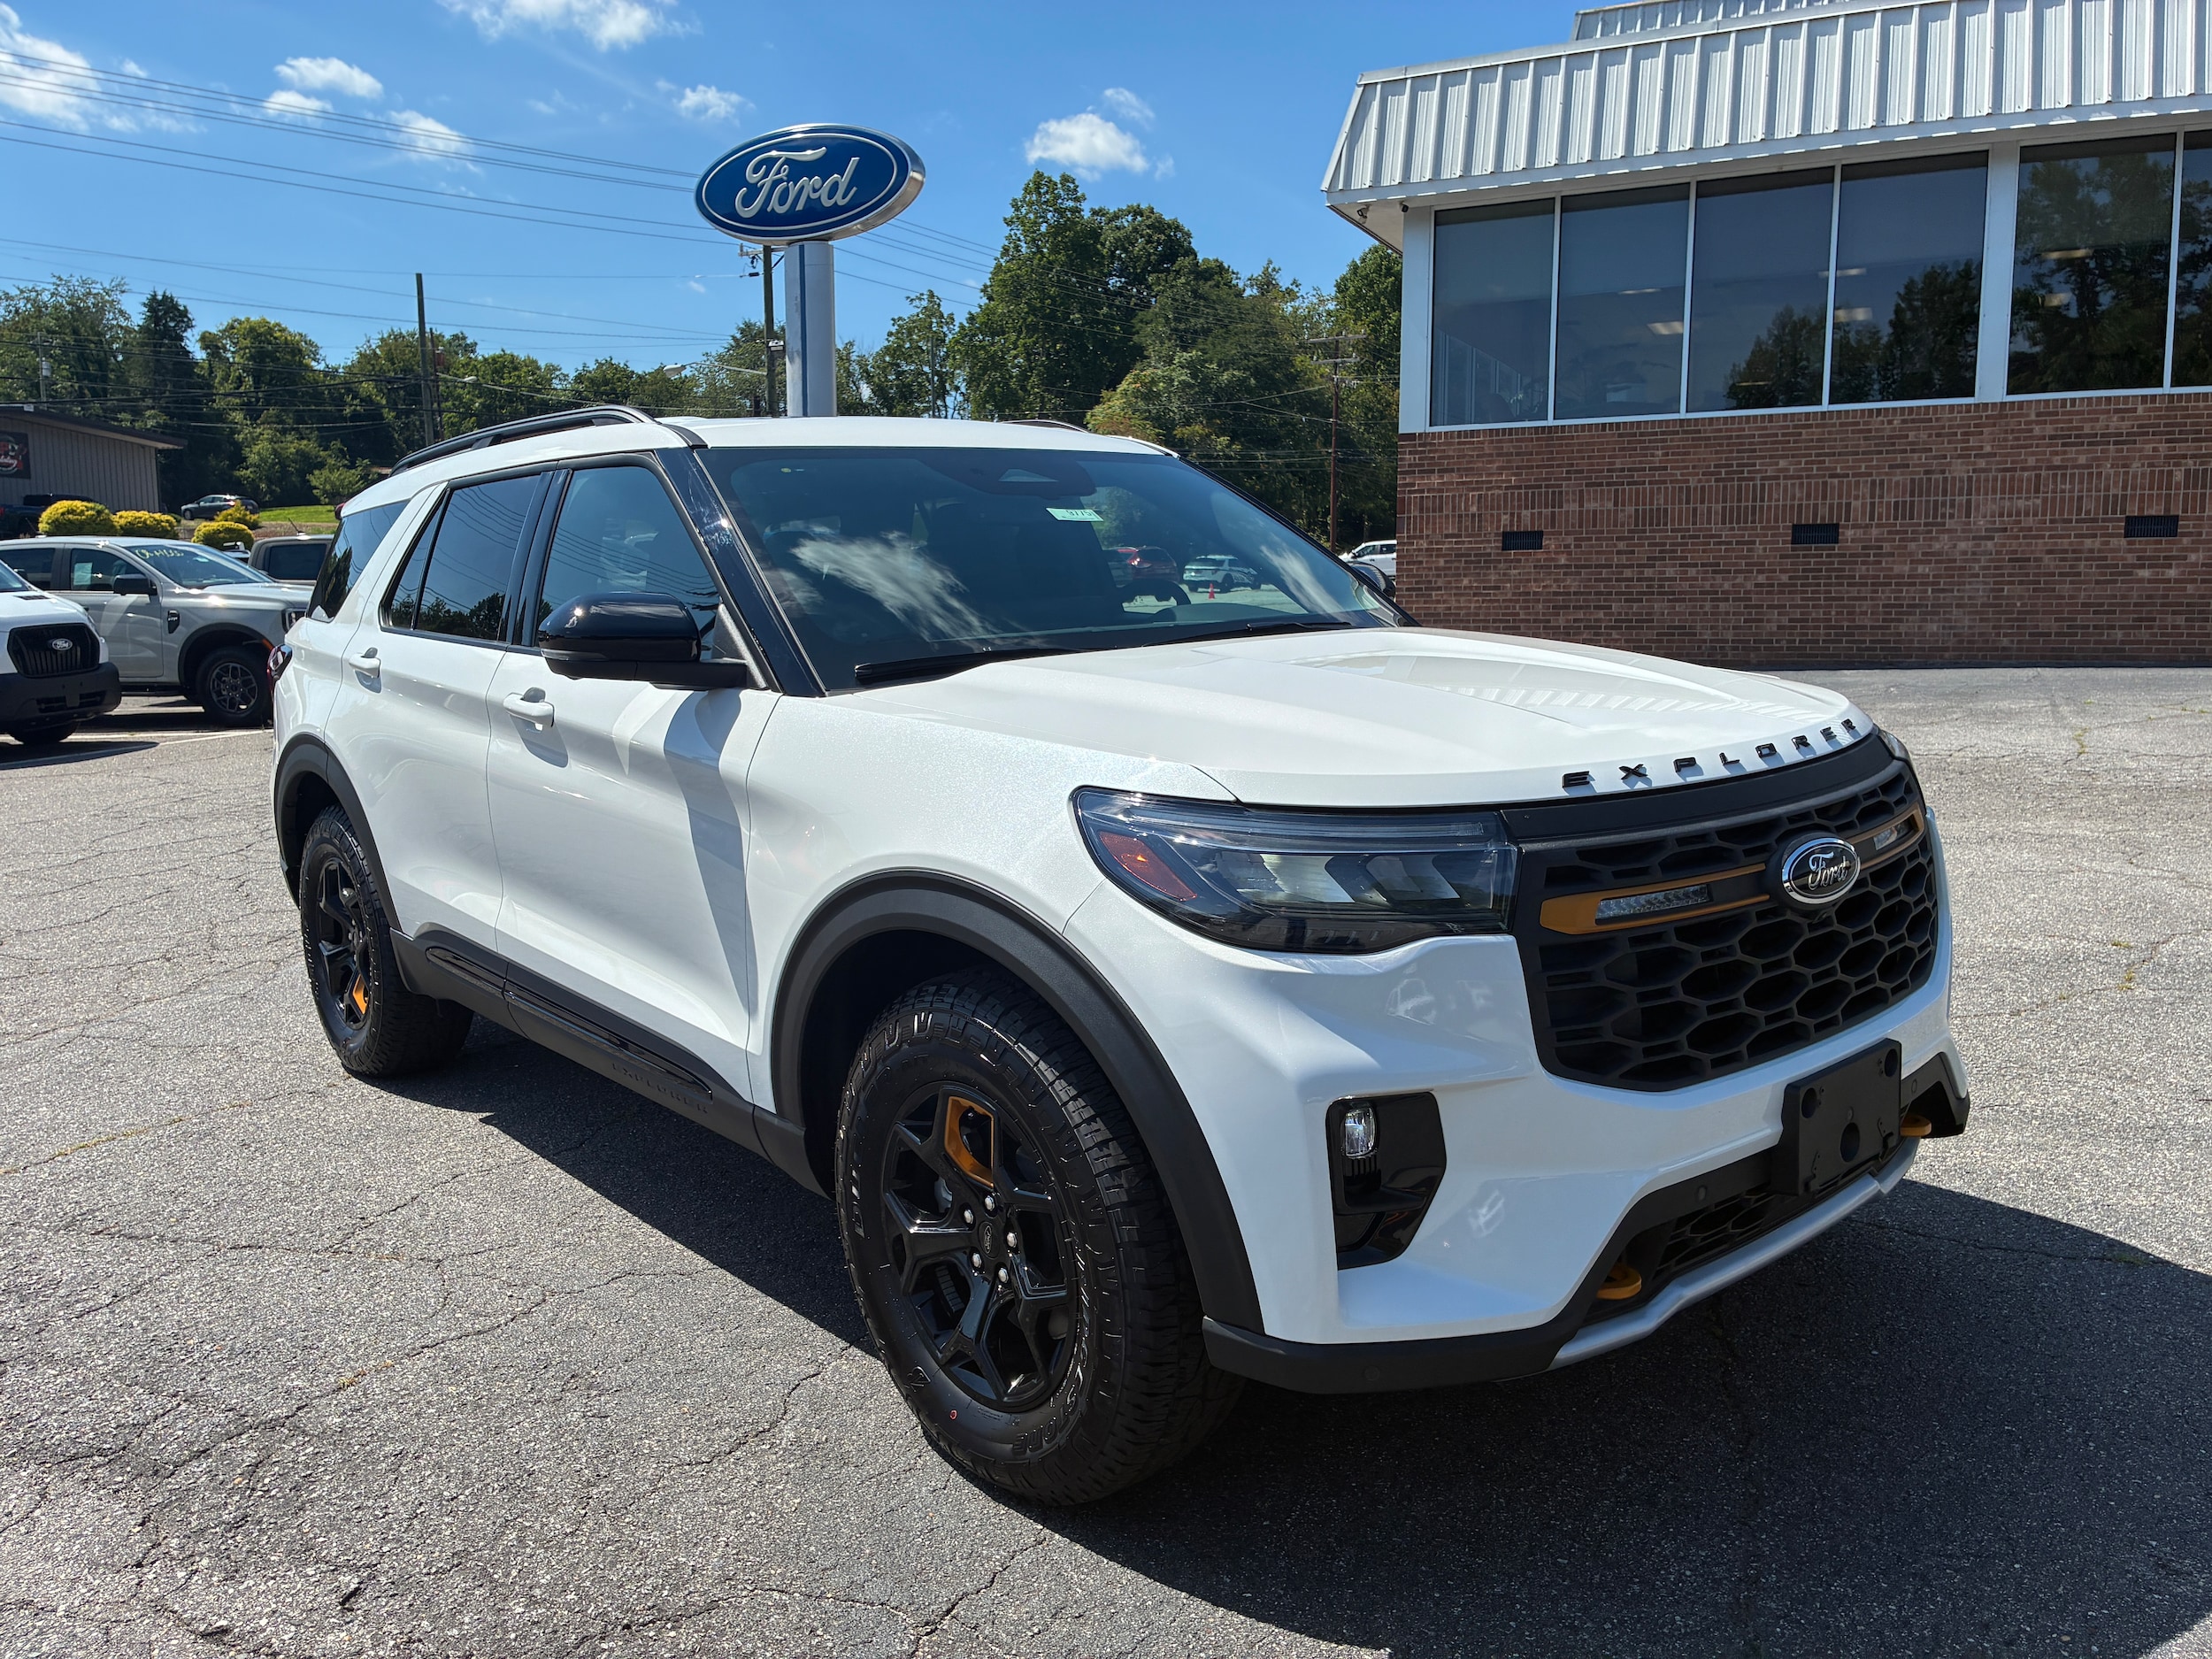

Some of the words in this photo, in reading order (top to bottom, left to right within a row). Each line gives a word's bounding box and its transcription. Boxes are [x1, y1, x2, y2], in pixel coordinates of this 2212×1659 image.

[734, 146, 861, 219] Ford
[1562, 718, 1857, 789] EXPLORER
[1808, 851, 1848, 891] Ford
